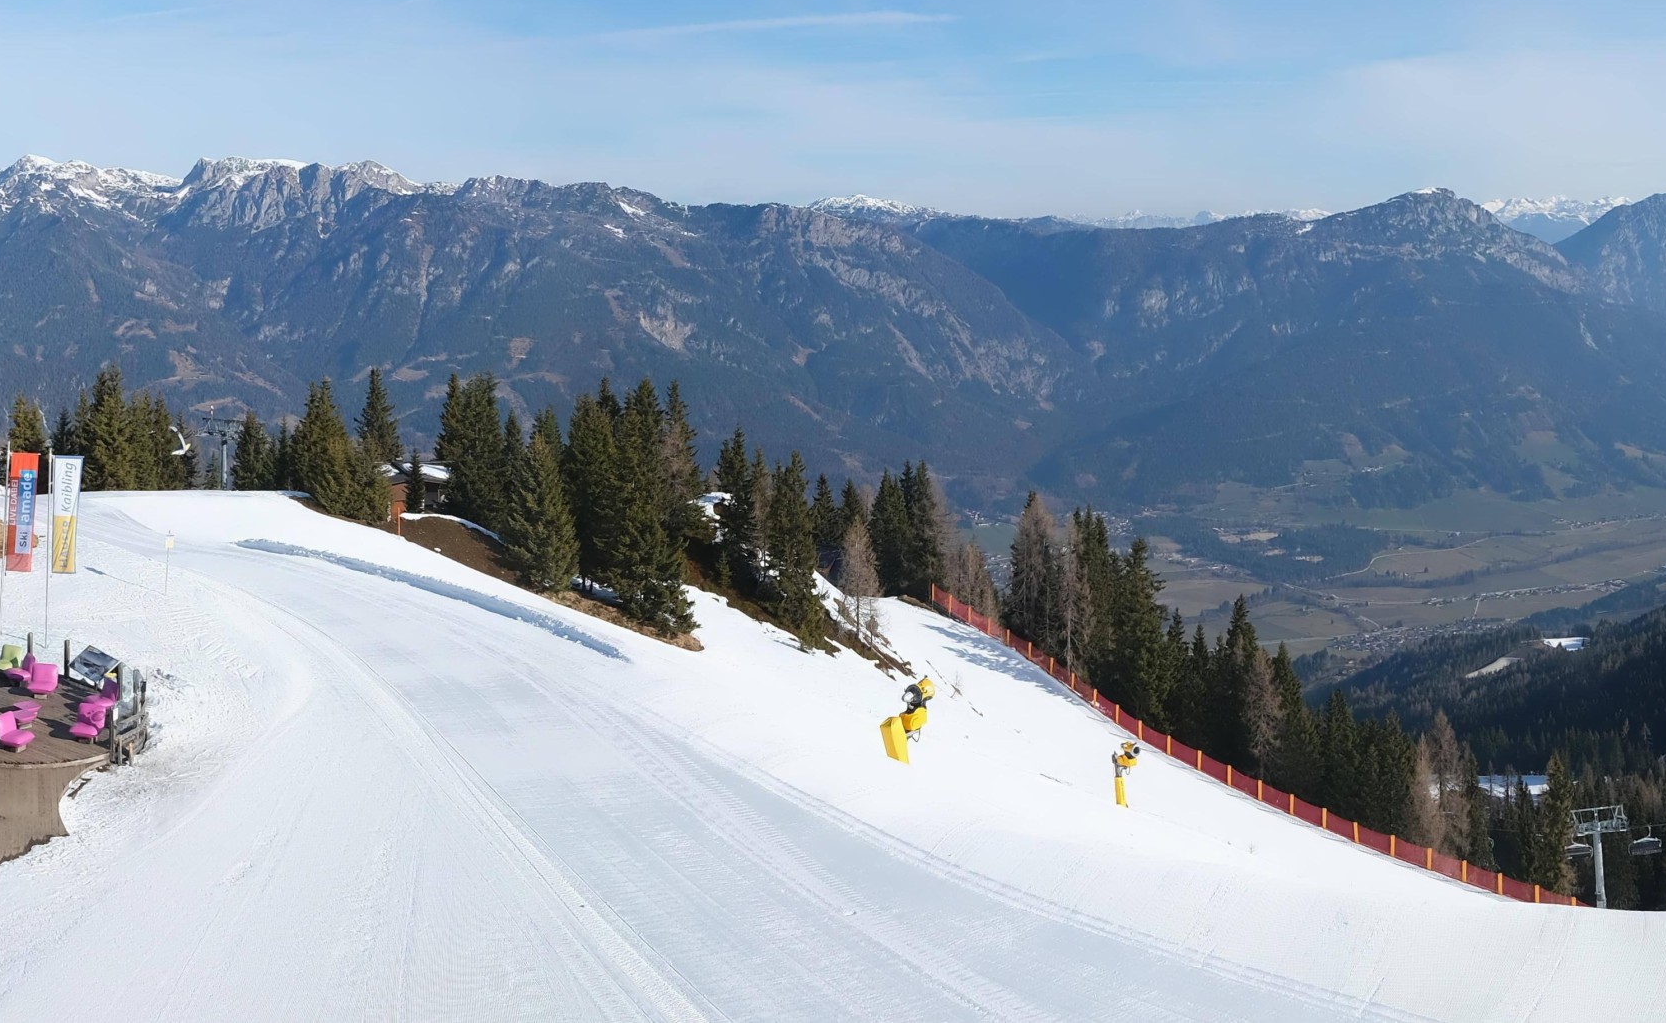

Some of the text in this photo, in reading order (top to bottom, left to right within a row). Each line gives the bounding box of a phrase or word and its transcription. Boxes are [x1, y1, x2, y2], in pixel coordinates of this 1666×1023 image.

[61, 462, 77, 513] Kaibling
[9, 505, 18, 525] LIVE
[19, 531, 29, 548] Ski
